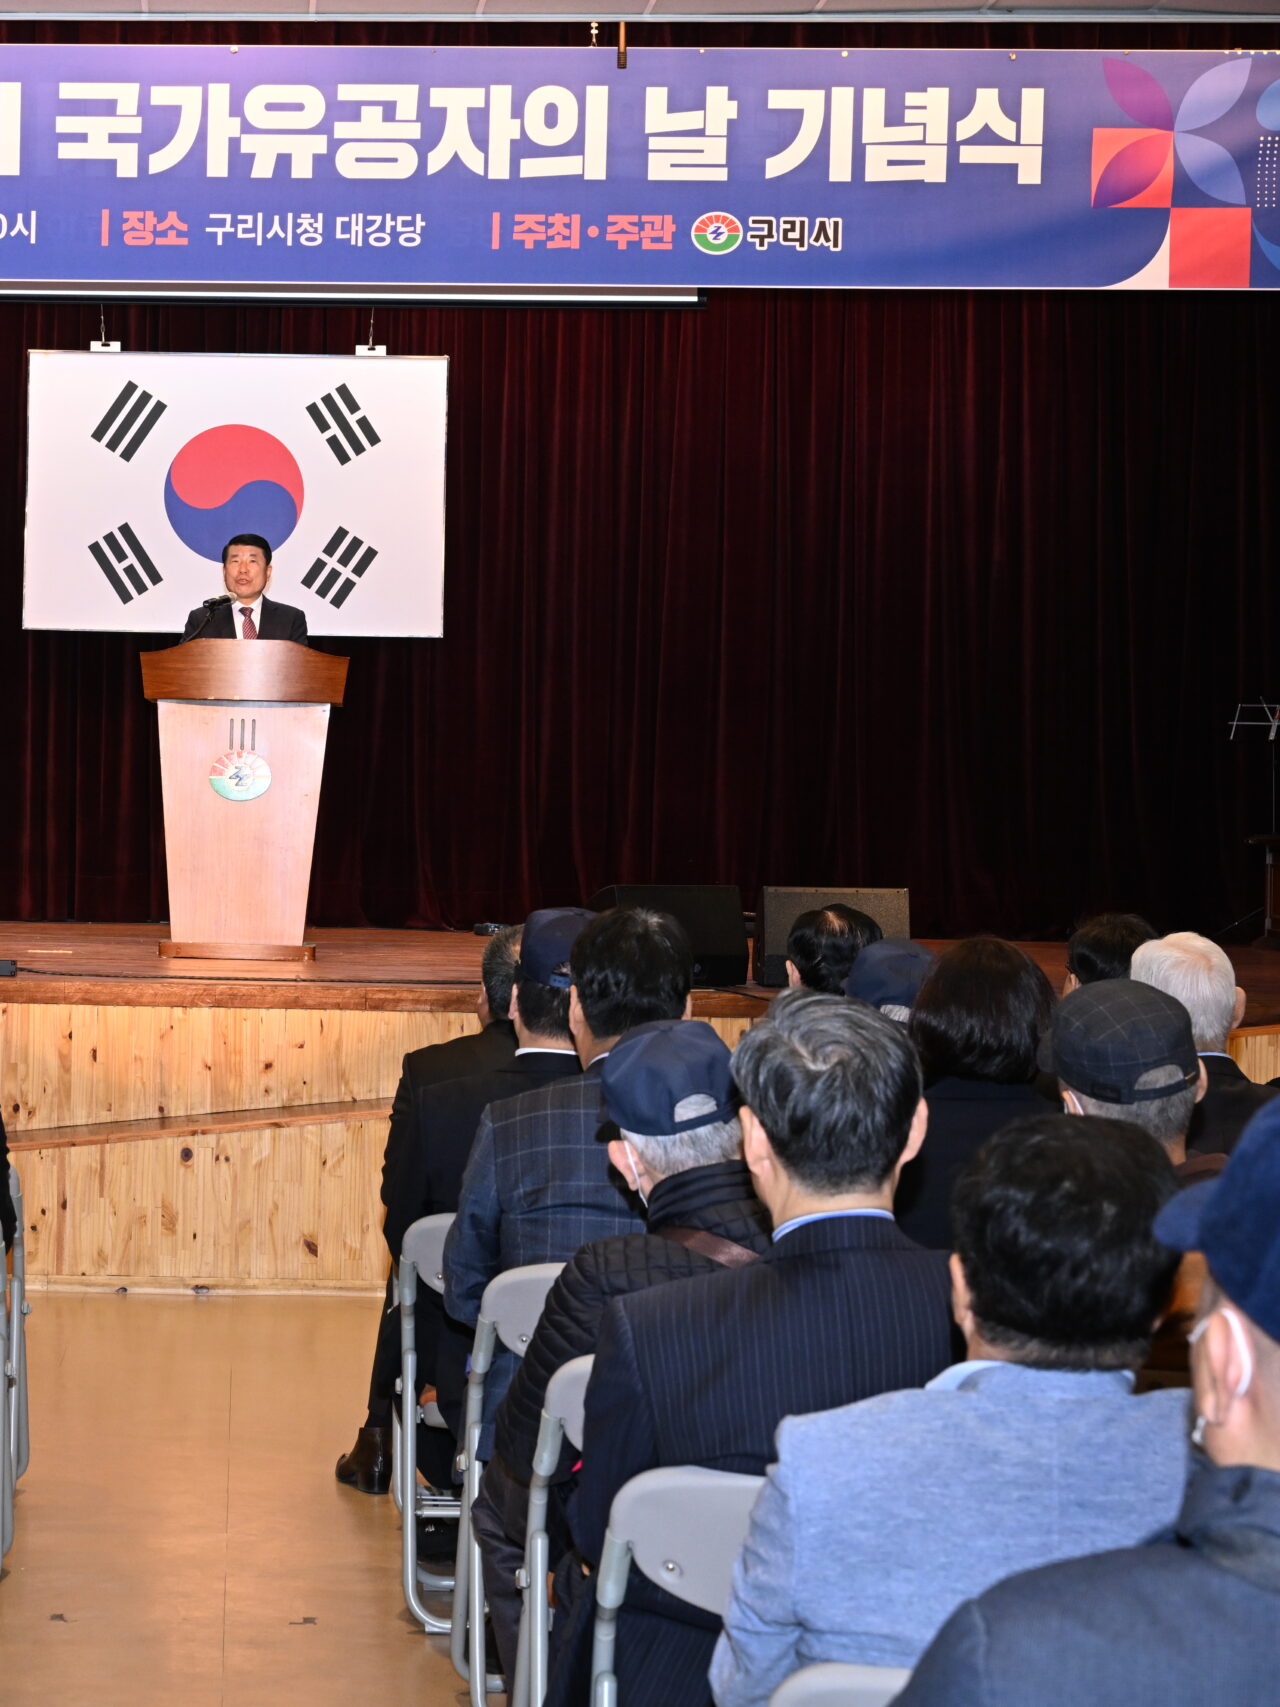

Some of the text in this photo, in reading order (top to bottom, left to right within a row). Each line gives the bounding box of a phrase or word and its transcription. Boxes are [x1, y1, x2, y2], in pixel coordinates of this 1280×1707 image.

[55, 81, 609, 181] 국가유공자의
[644, 85, 738, 182] 날
[764, 86, 1045, 185] 기념식
[122, 210, 426, 247] 장소 구리시청 대강당
[748, 217, 841, 250] 구리시
